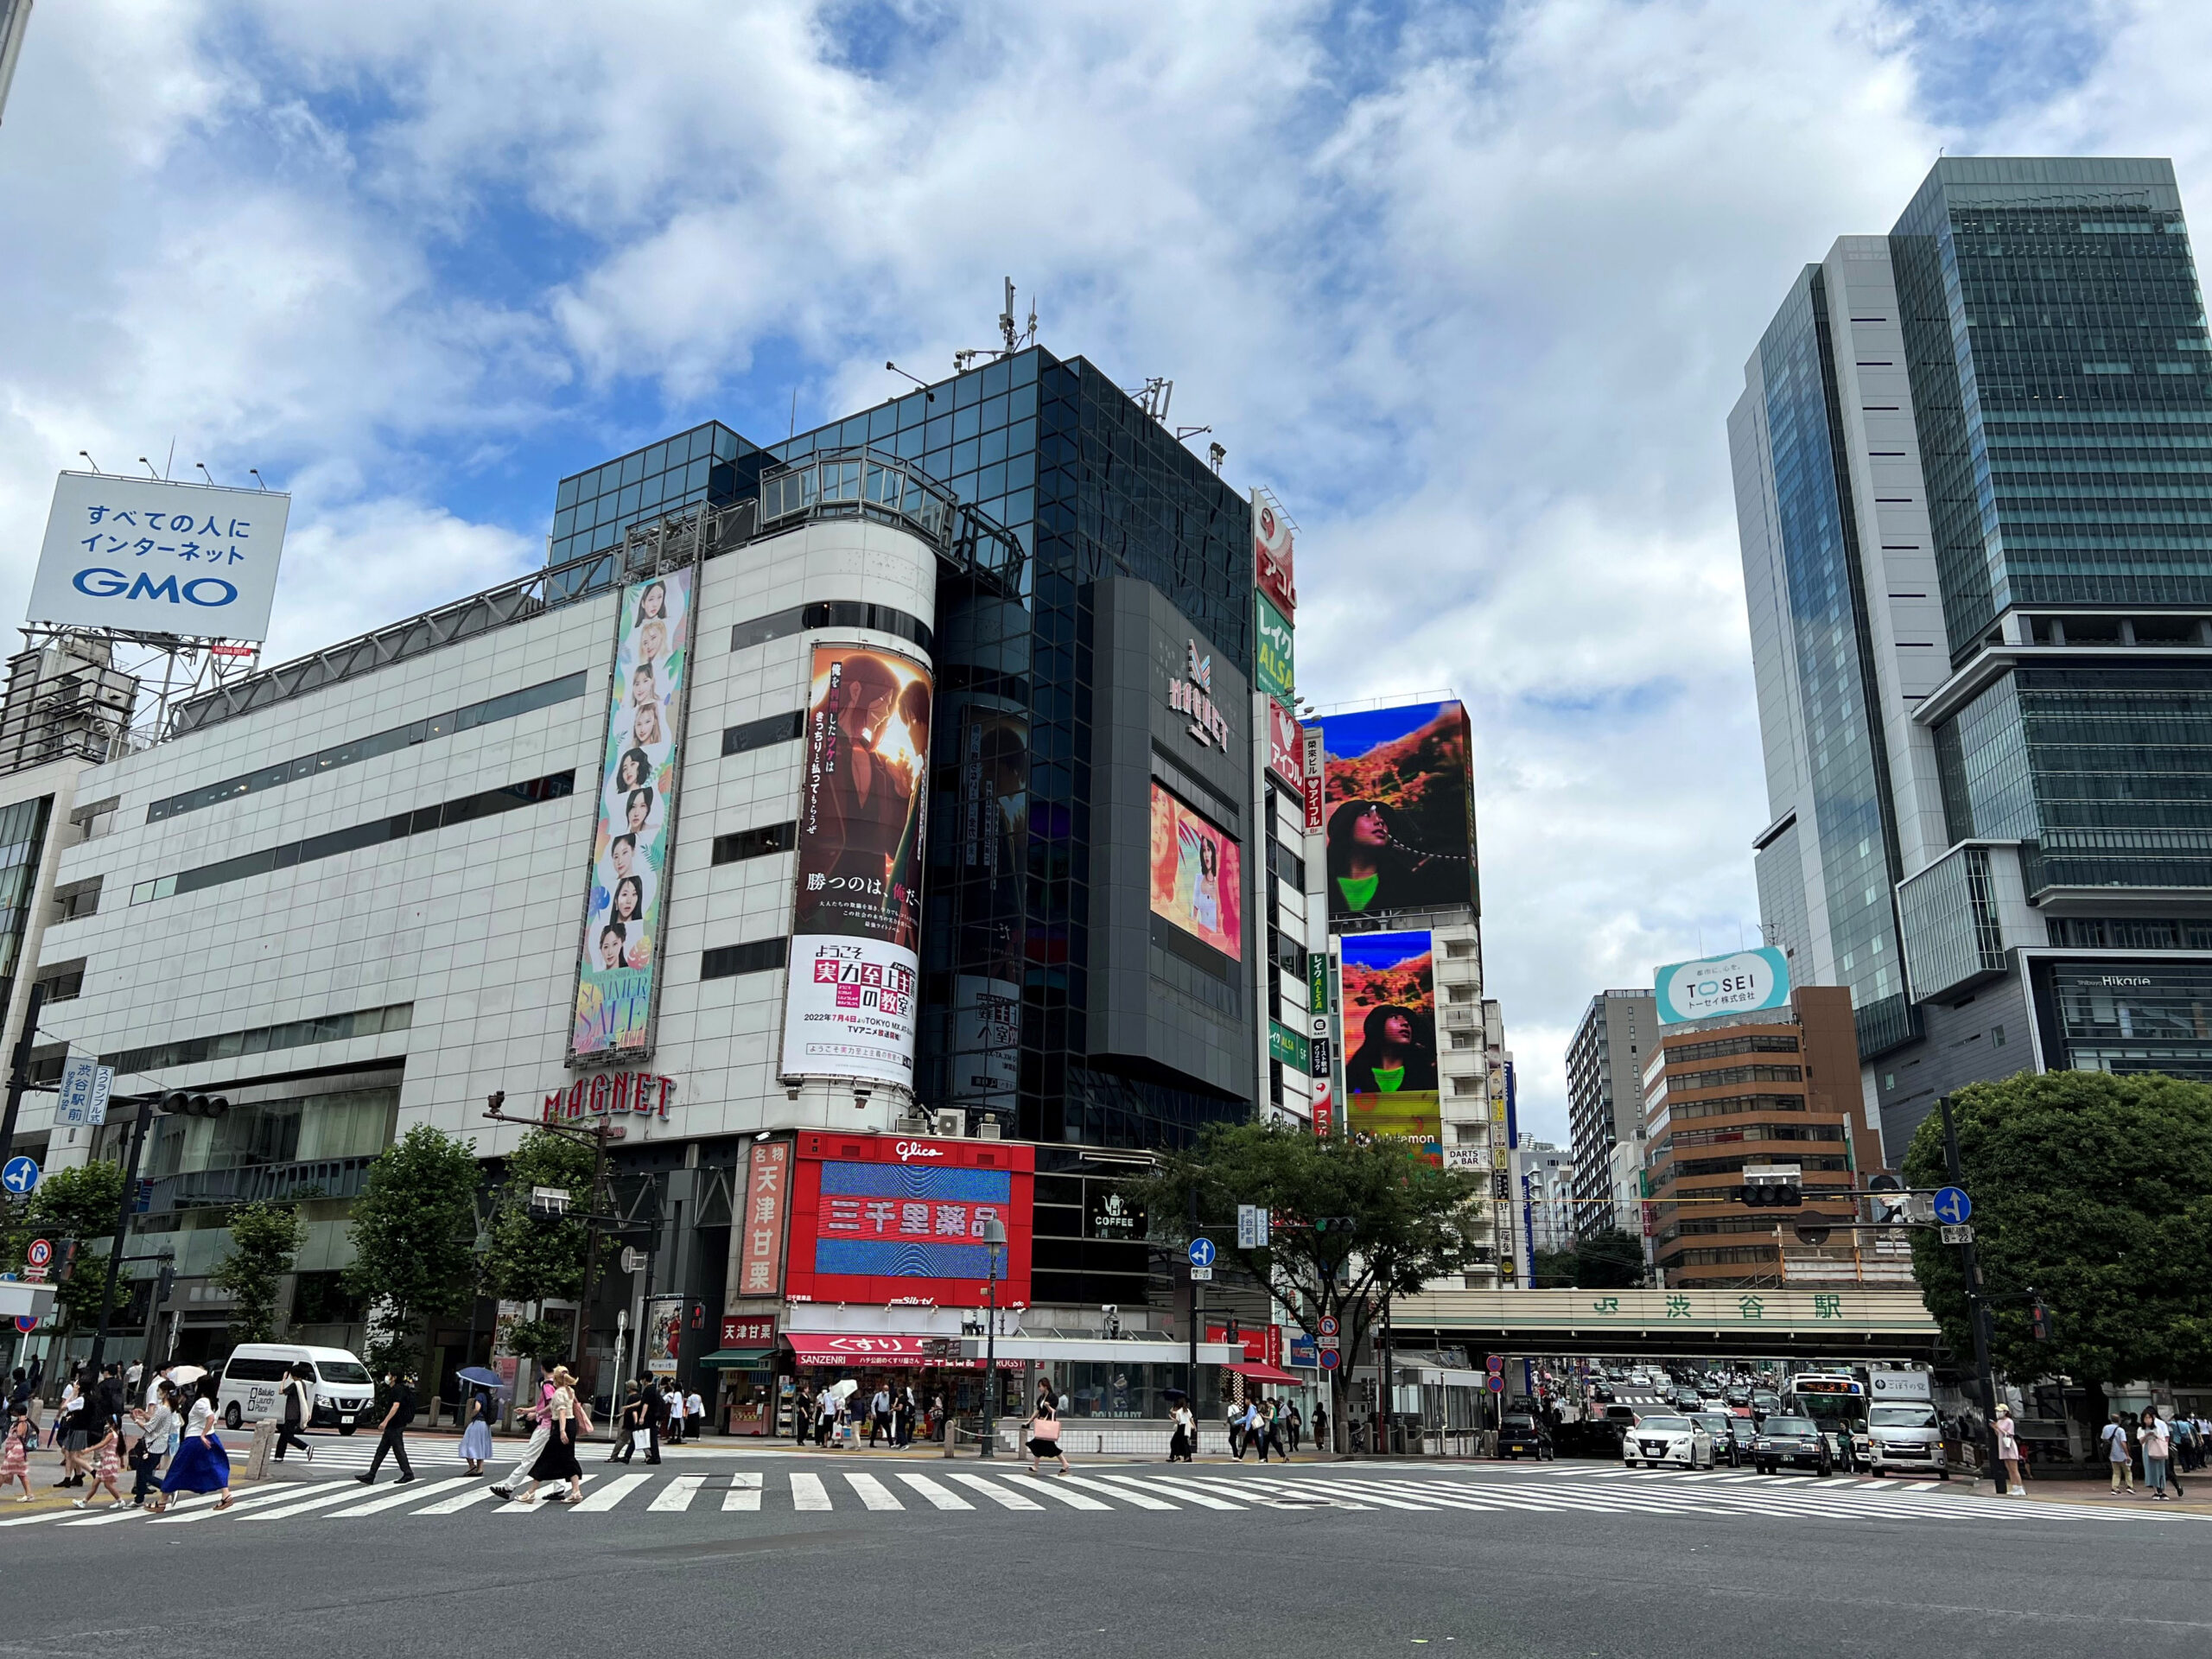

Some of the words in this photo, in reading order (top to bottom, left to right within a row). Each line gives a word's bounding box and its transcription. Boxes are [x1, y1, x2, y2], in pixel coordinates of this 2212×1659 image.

[87, 505, 251, 538] すべての人に
[80, 533, 245, 566] インターネット
[72, 567, 238, 607] GMO
[1264, 553, 1298, 609] アコム
[1259, 605, 1294, 661] レイク
[1259, 642, 1294, 690] ALSA
[1169, 677, 1228, 753] MAGNET
[806, 711, 824, 835] きっちりと払ってもらうぜ
[1271, 741, 1303, 787] アイフル
[1308, 790, 1320, 826] アイフル
[816, 945, 863, 959] ようこそ
[1313, 955, 1322, 978] レイク
[580, 977, 648, 1004] SUMMER
[1314, 978, 1323, 1009] ALSA
[1687, 974, 1754, 998] TOSEI
[2101, 976, 2151, 987] Hikarie
[862, 990, 914, 1020] の教室へ
[1688, 992, 1755, 1009] トーセイ株式会社
[576, 996, 646, 1039] SALE
[1281, 1036, 1294, 1051] ALSA
[1300, 1048, 1306, 1061] 5F
[63, 1071, 76, 1097] Shibuya
[67, 1064, 92, 1122] 渋谷駅前
[90, 1068, 110, 1122] スクランブル式
[543, 1071, 677, 1123] MAGNET
[754, 1146, 785, 1163] 名物
[895, 1141, 944, 1161] Glico
[1450, 1149, 1479, 1159] DARTS
[1461, 1156, 1479, 1165] BAR
[828, 1199, 997, 1237] 三千里薬品
[1498, 1203, 1509, 1211] 3F
[748, 1166, 778, 1289] 天津甘栗
[1096, 1217, 1134, 1227] COFFEE
[1593, 1297, 1619, 1311] JR
[724, 1324, 772, 1339] 天津甘栗
[830, 1338, 902, 1351] くすり
[800, 1355, 846, 1363] SANZENRI
[256, 1398, 275, 1408] Laundry
[257, 1388, 275, 1396] Baluko
